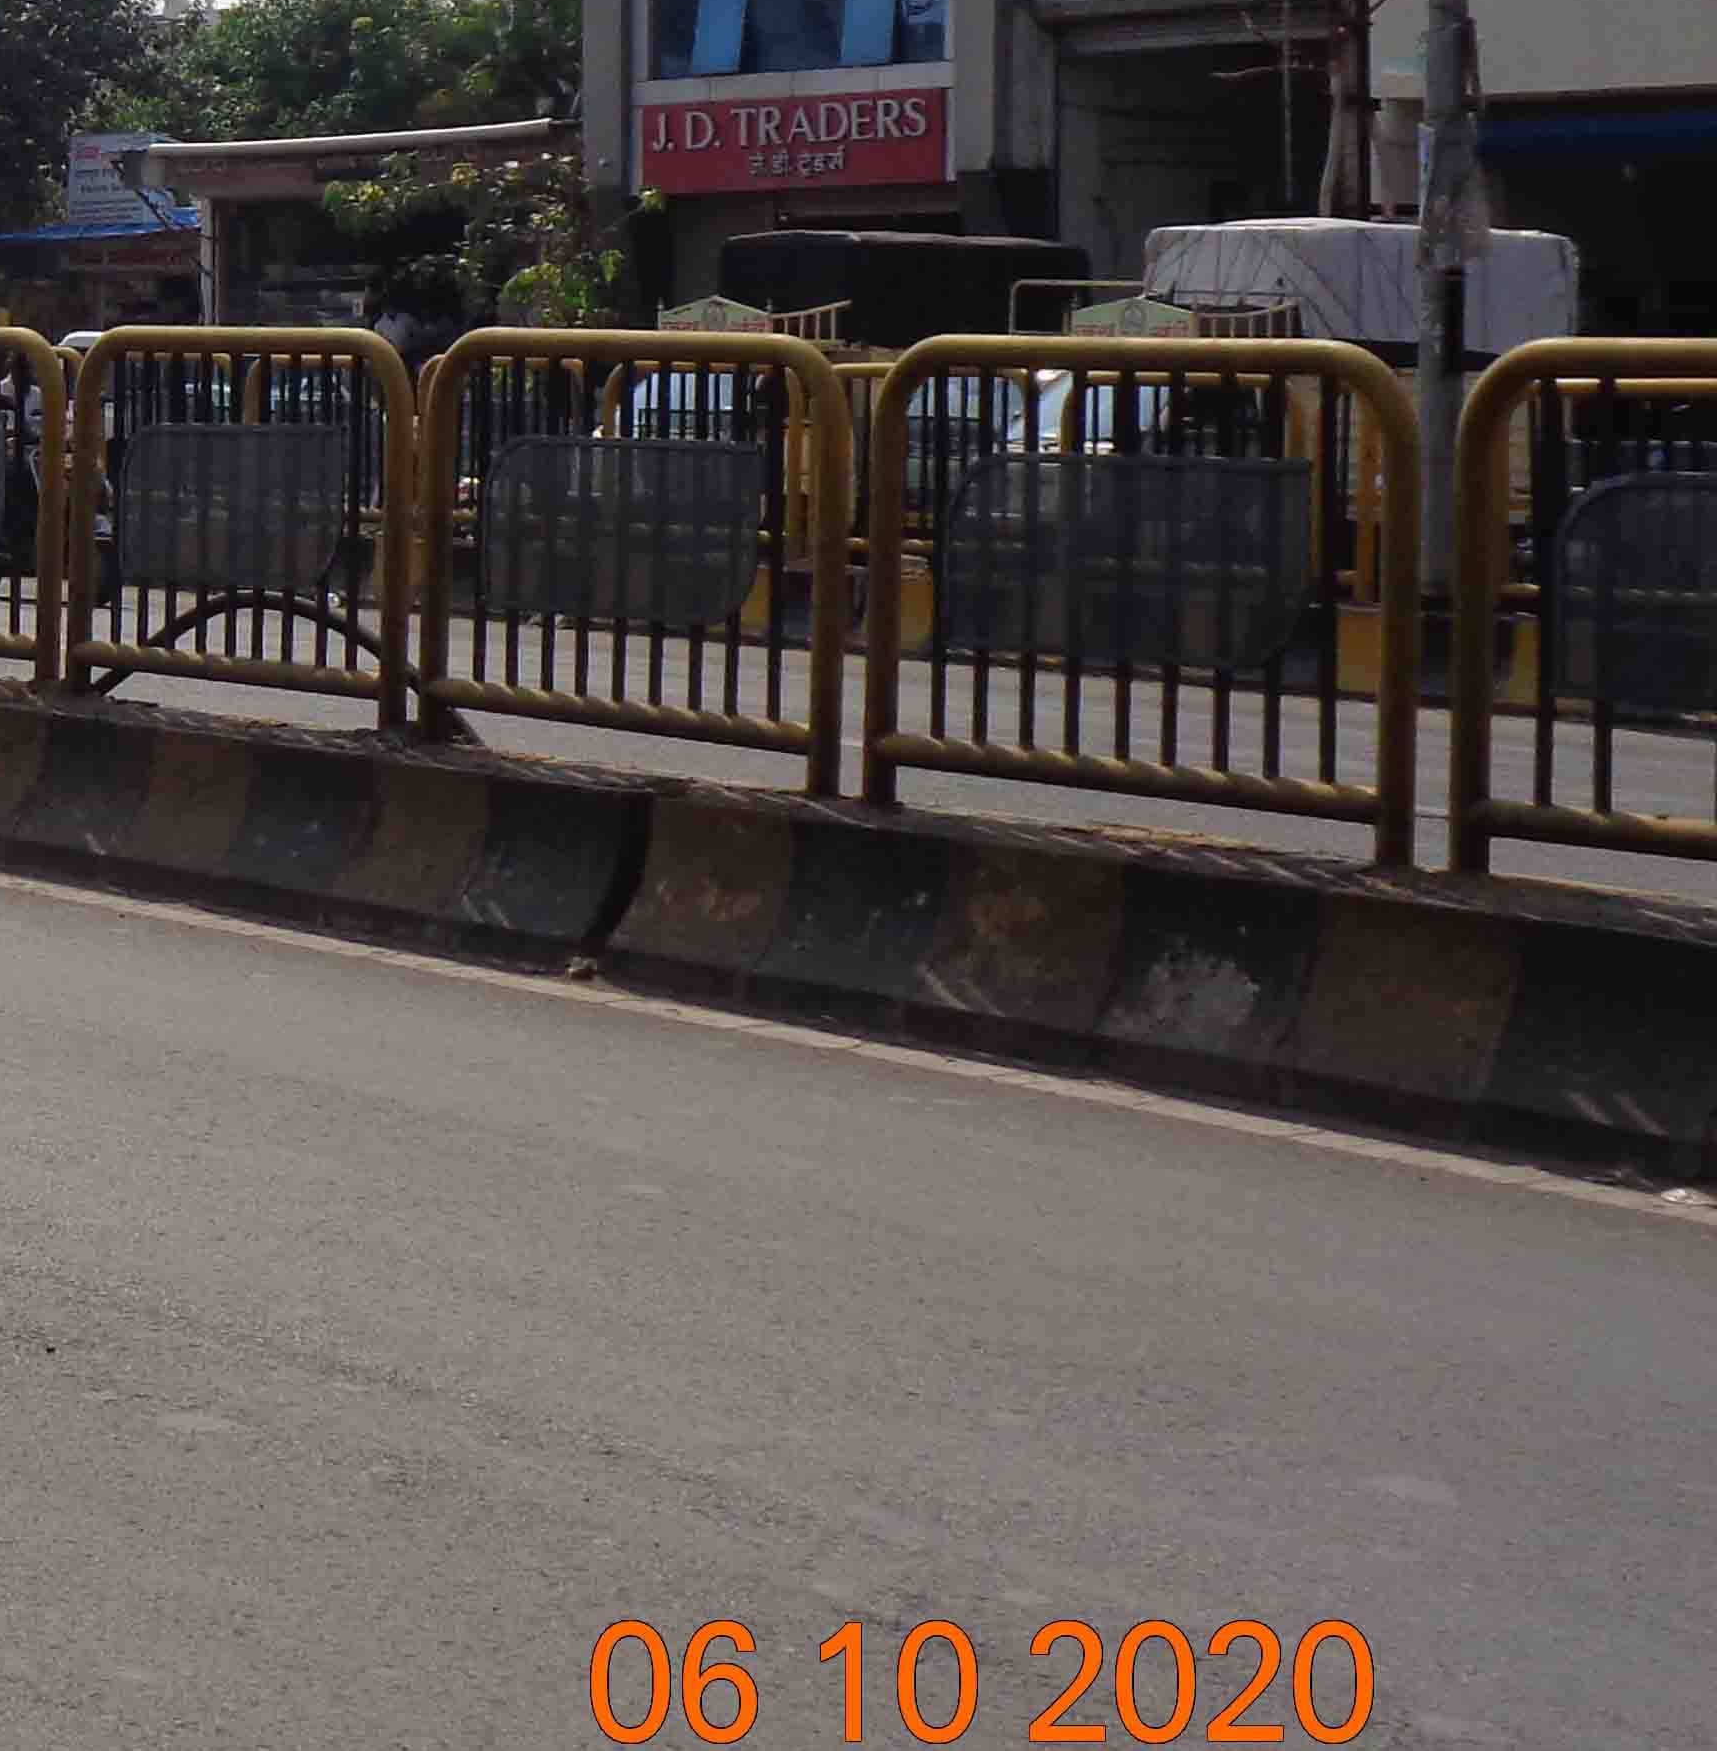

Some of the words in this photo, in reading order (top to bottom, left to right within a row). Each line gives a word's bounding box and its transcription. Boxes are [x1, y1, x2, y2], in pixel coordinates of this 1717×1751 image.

[652, 112, 674, 152] J.
[684, 110, 721, 151] D.
[729, 98, 927, 147] TRADERS
